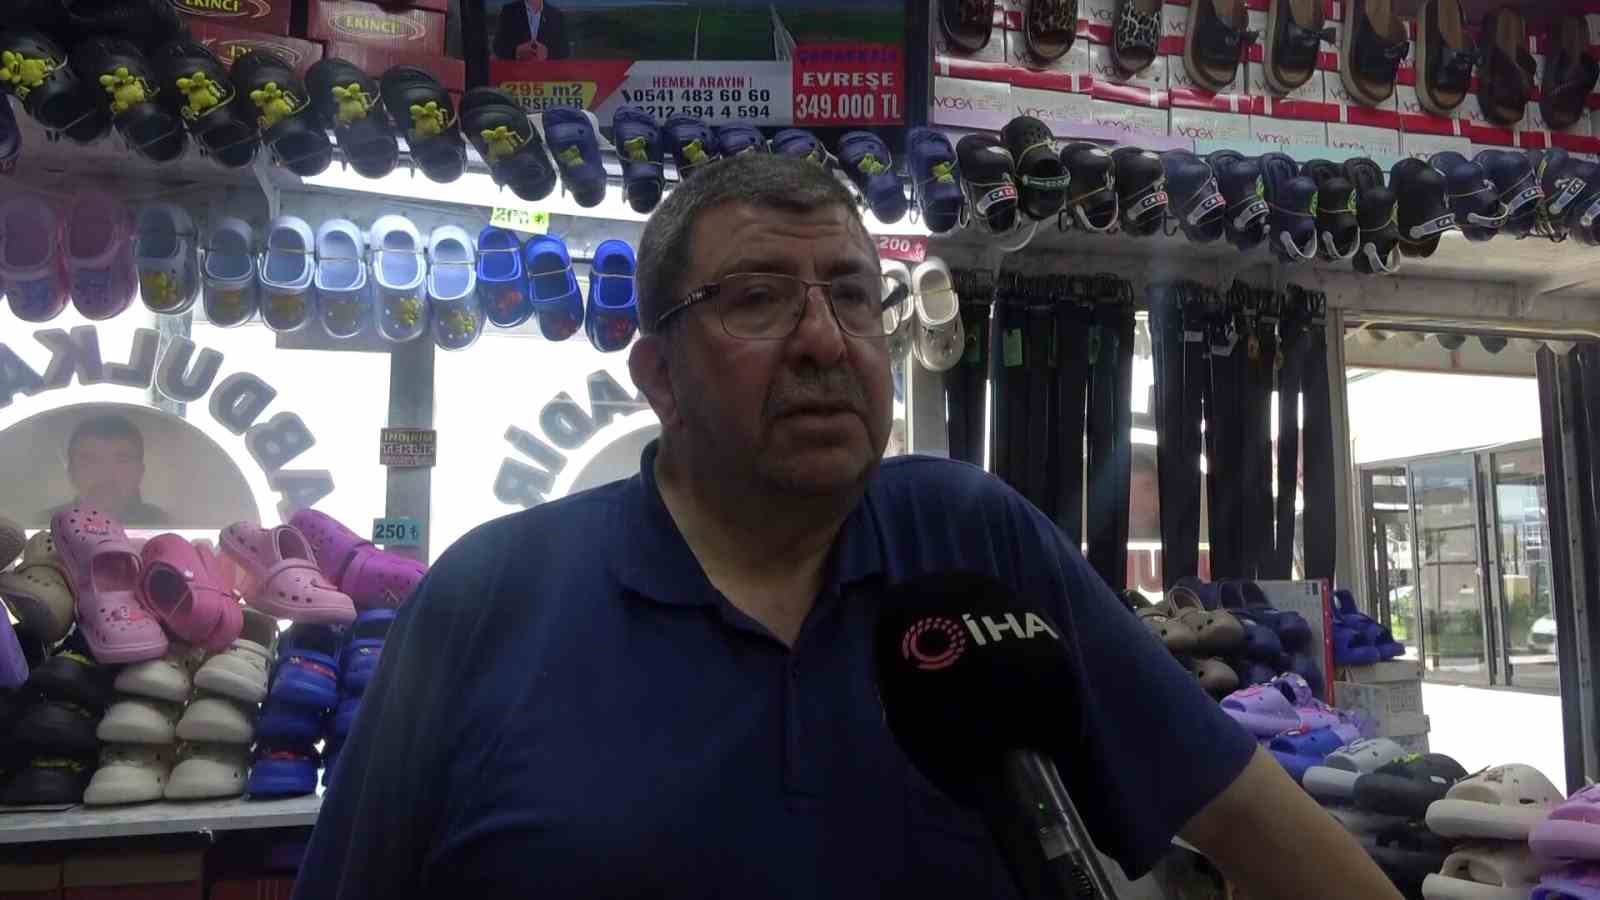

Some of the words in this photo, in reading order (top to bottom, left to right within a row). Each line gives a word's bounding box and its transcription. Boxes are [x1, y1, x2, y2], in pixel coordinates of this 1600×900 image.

[652, 76, 695, 88] HEMEN
[699, 76, 744, 88] ARAYIN
[802, 71, 894, 90] EVREŞE
[506, 83, 544, 97] 295
[552, 83, 583, 97] m2
[634, 89, 673, 102] 0541
[681, 89, 713, 102] 483
[719, 89, 741, 102] 60
[747, 89, 770, 102] 60
[682, 105, 714, 118] 594
[720, 105, 731, 118] 4
[737, 105, 770, 118] 594
[796, 93, 874, 119] 349.000
[881, 93, 901, 119] TL
[880, 236, 910, 252] 200
[375, 524, 405, 540] 250
[961, 611, 1059, 646] İHA
